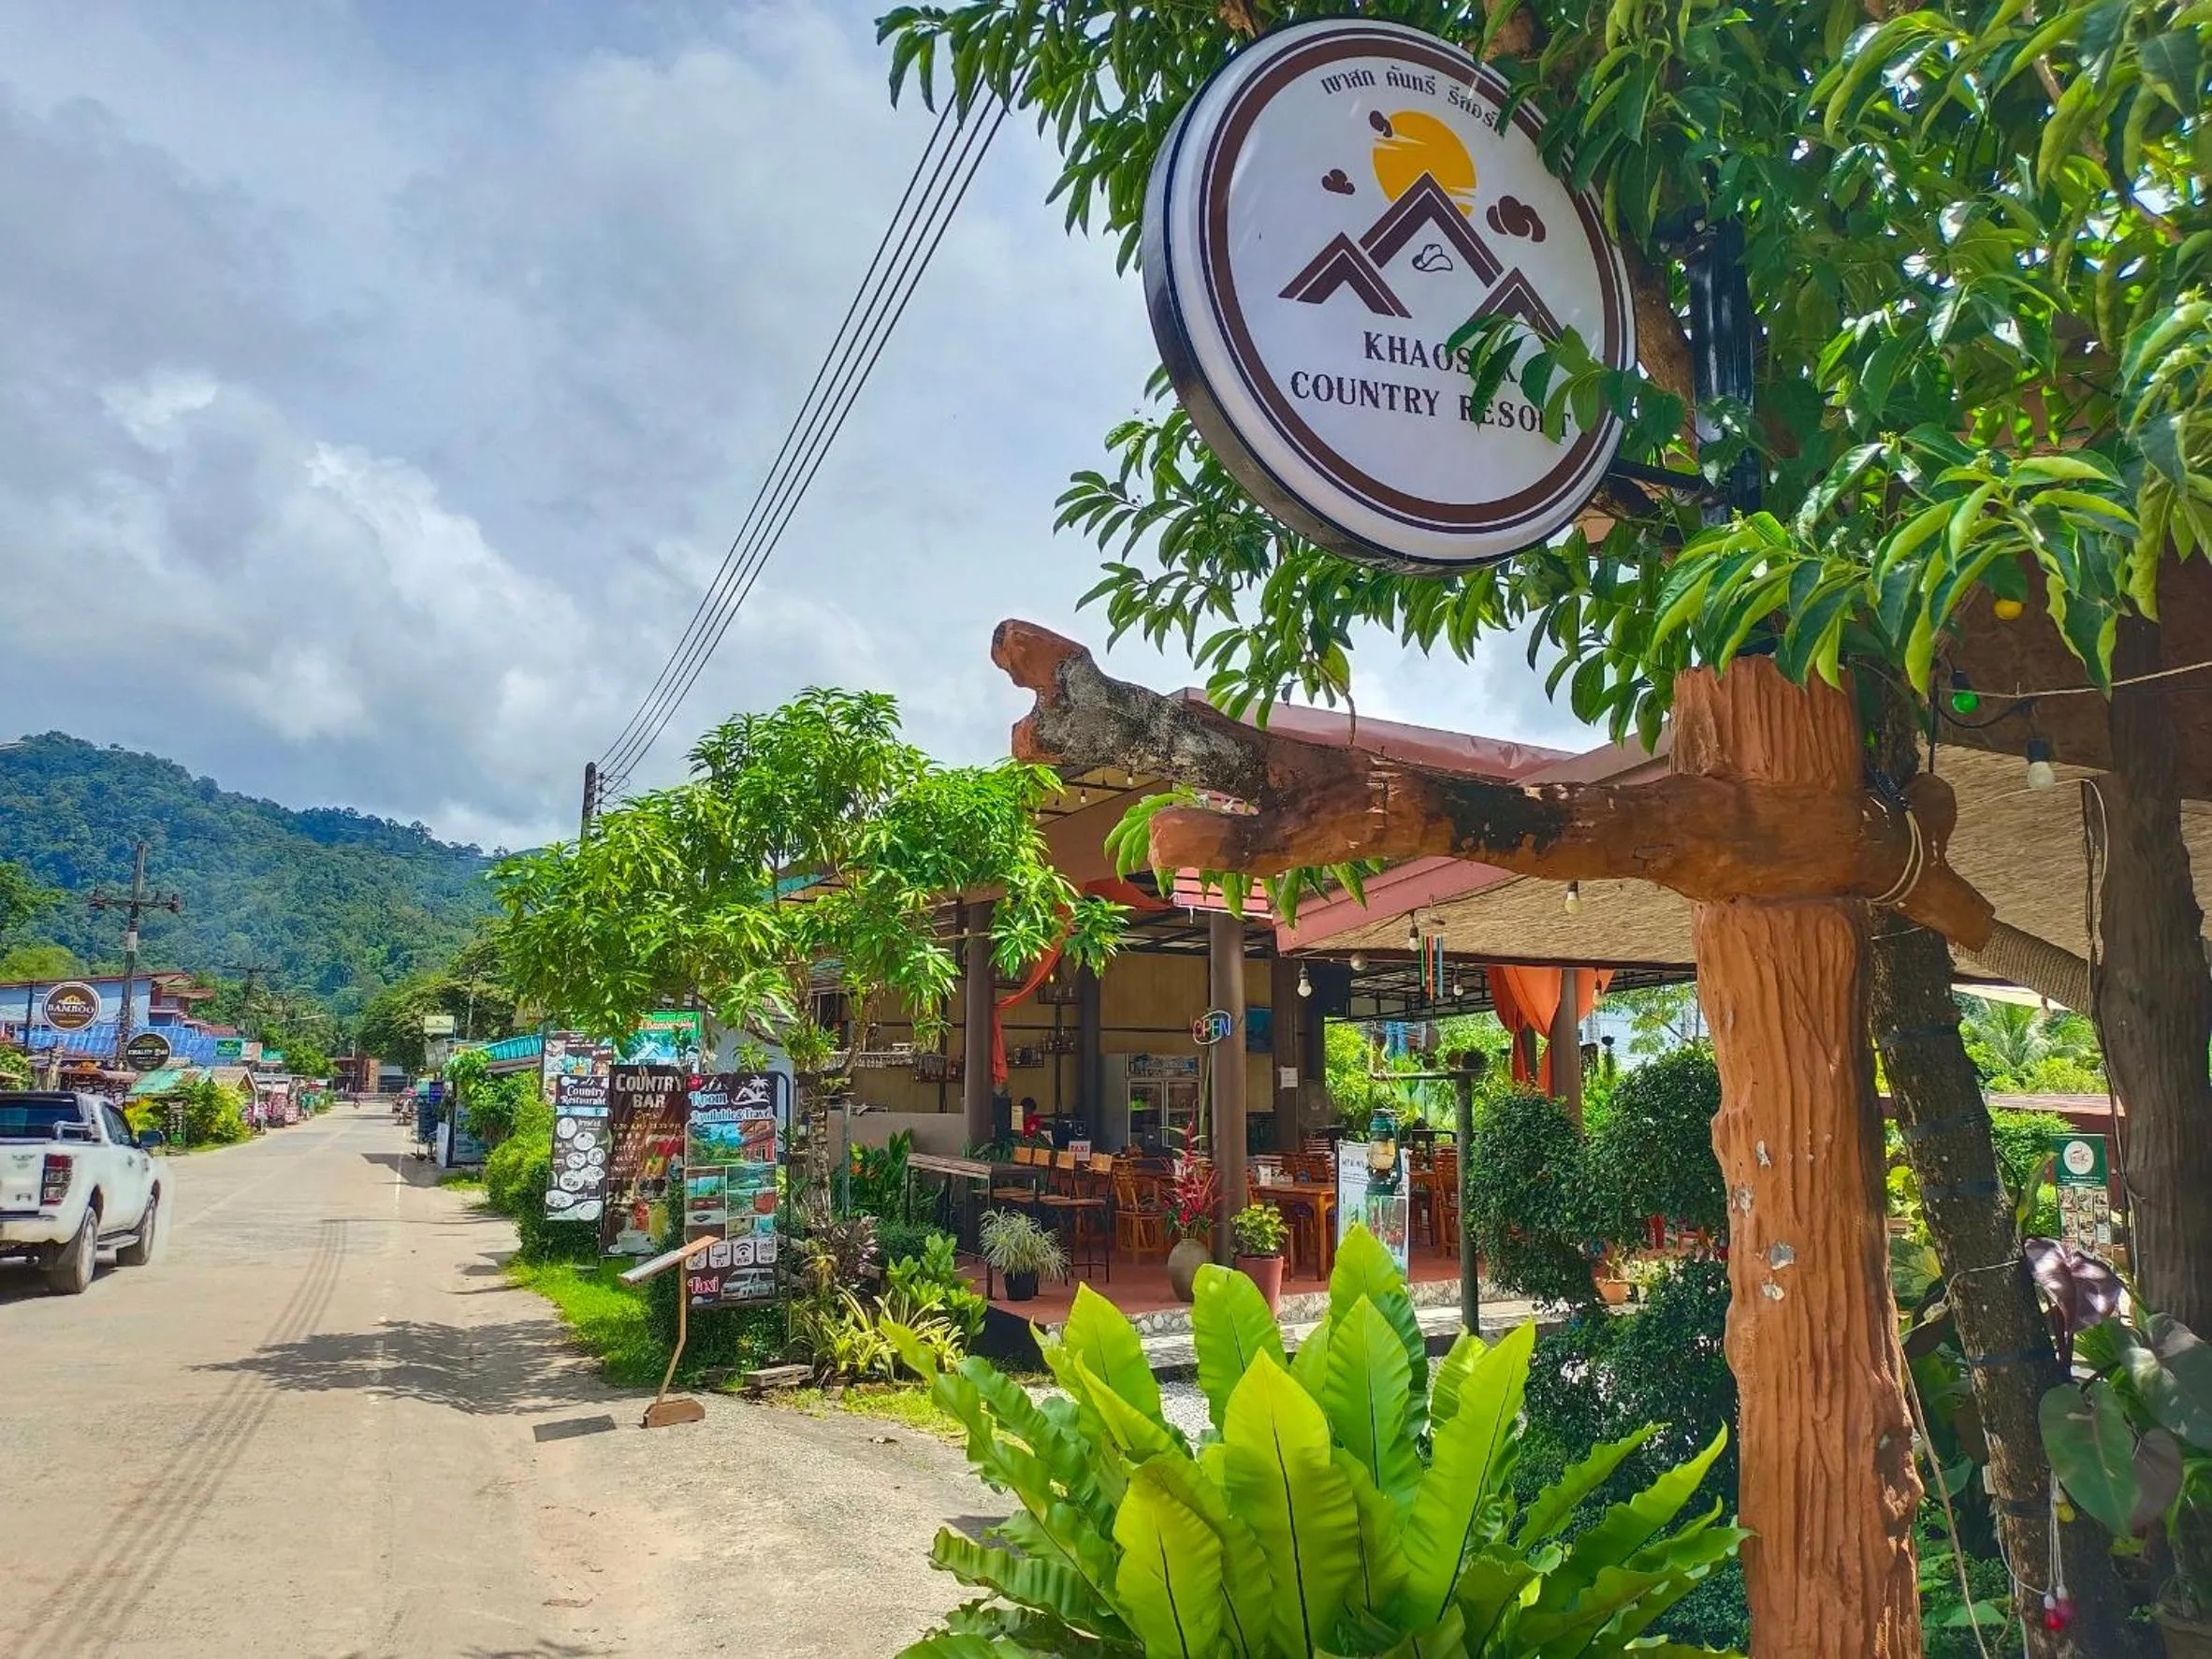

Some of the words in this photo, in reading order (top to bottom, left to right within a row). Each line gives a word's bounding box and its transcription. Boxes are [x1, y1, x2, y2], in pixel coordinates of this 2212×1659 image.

[1386, 65, 1436, 95] คันทรี
[1448, 84, 1502, 137] รีสอร์
[1290, 371, 1440, 416] COUNTRY
[48, 1003, 95, 1014] BAMBOO
[1192, 1018, 1231, 1038] OPEN
[567, 1084, 605, 1098] Country
[616, 1072, 682, 1092] COUNTRY
[633, 1093, 666, 1108] BAR
[689, 1090, 728, 1107] Room
[688, 1275, 720, 1294] Taxi
